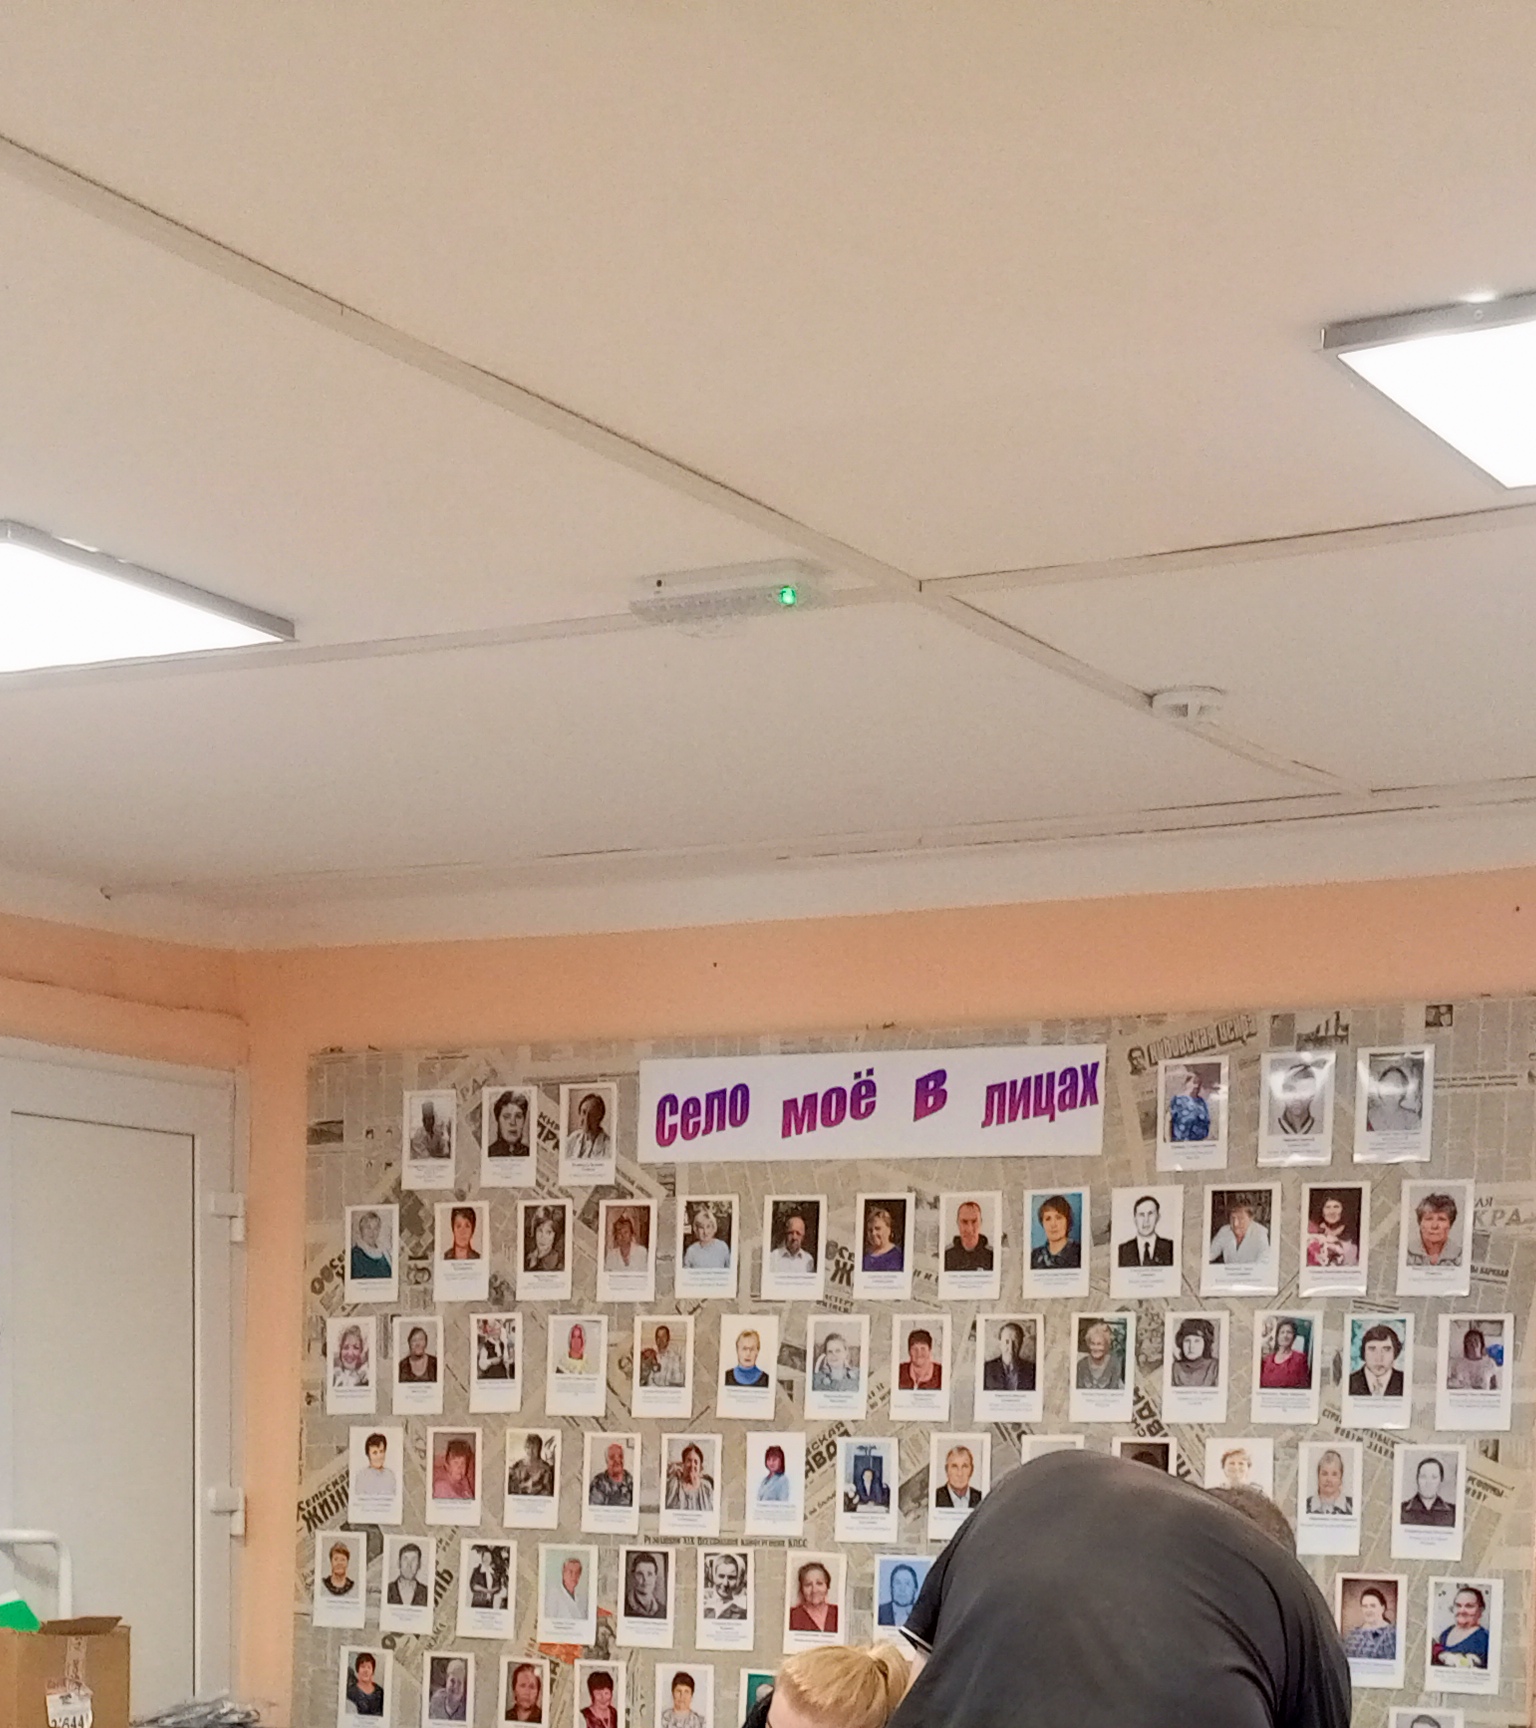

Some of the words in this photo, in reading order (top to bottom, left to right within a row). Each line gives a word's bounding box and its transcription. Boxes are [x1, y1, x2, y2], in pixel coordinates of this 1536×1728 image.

[655, 1083, 750, 1148] Село
[781, 1067, 877, 1139] моё
[981, 1061, 1100, 1129] лицах
[1472, 1208, 1522, 1227] КРА
[302, 1480, 350, 1534] ЖИЗН
